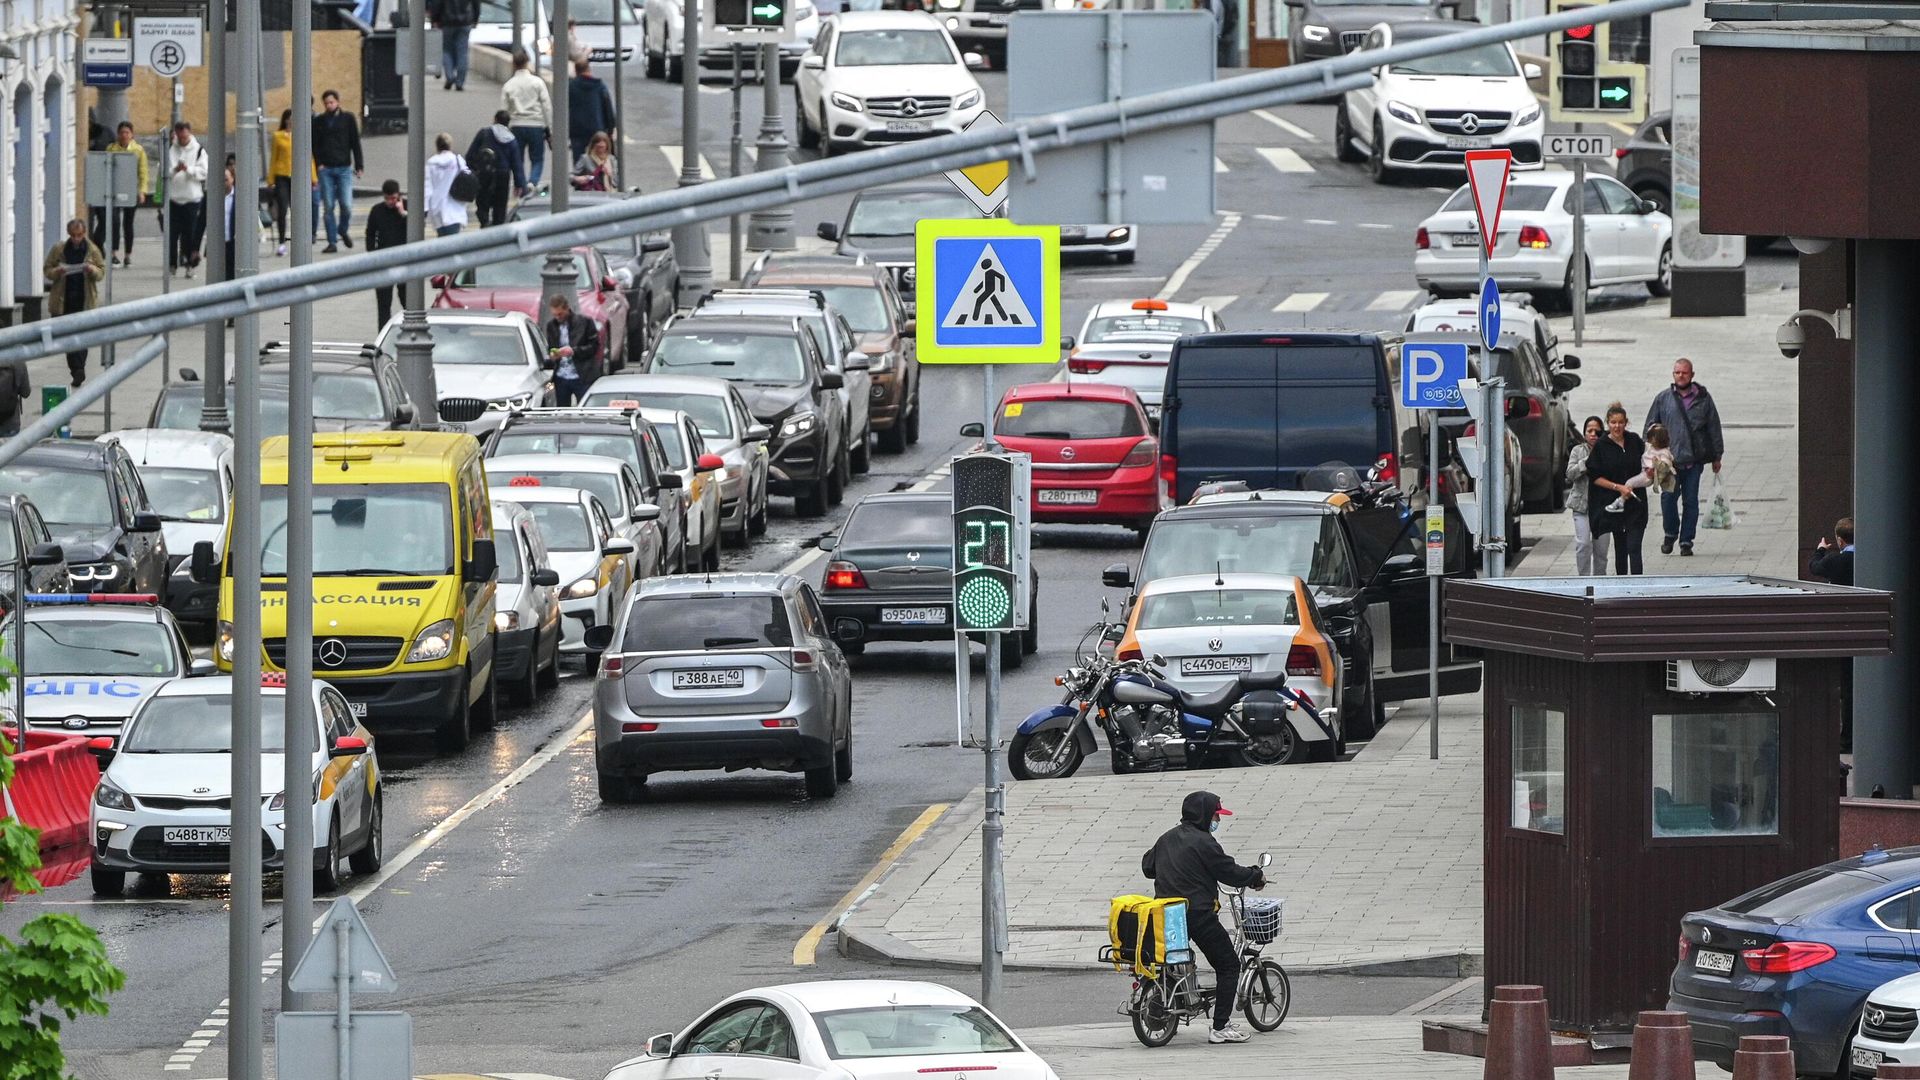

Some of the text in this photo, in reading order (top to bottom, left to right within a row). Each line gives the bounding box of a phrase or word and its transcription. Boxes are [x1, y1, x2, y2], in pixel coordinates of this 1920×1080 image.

[1551, 138, 1603, 153] СТОП
[1409, 350, 1444, 400] P
[1435, 389, 1444, 399] 15
[1446, 389, 1460, 399] 20
[1041, 490, 1077, 501] Е280ТТ
[965, 521, 1009, 567] 27
[885, 608, 943, 620] О950АВ 177
[1184, 657, 1247, 671] С449ОЕ 799
[678, 670, 739, 684] Р388АЕ 40
[25, 681, 141, 698] ДПС
[167, 829, 214, 841] О488ТК
